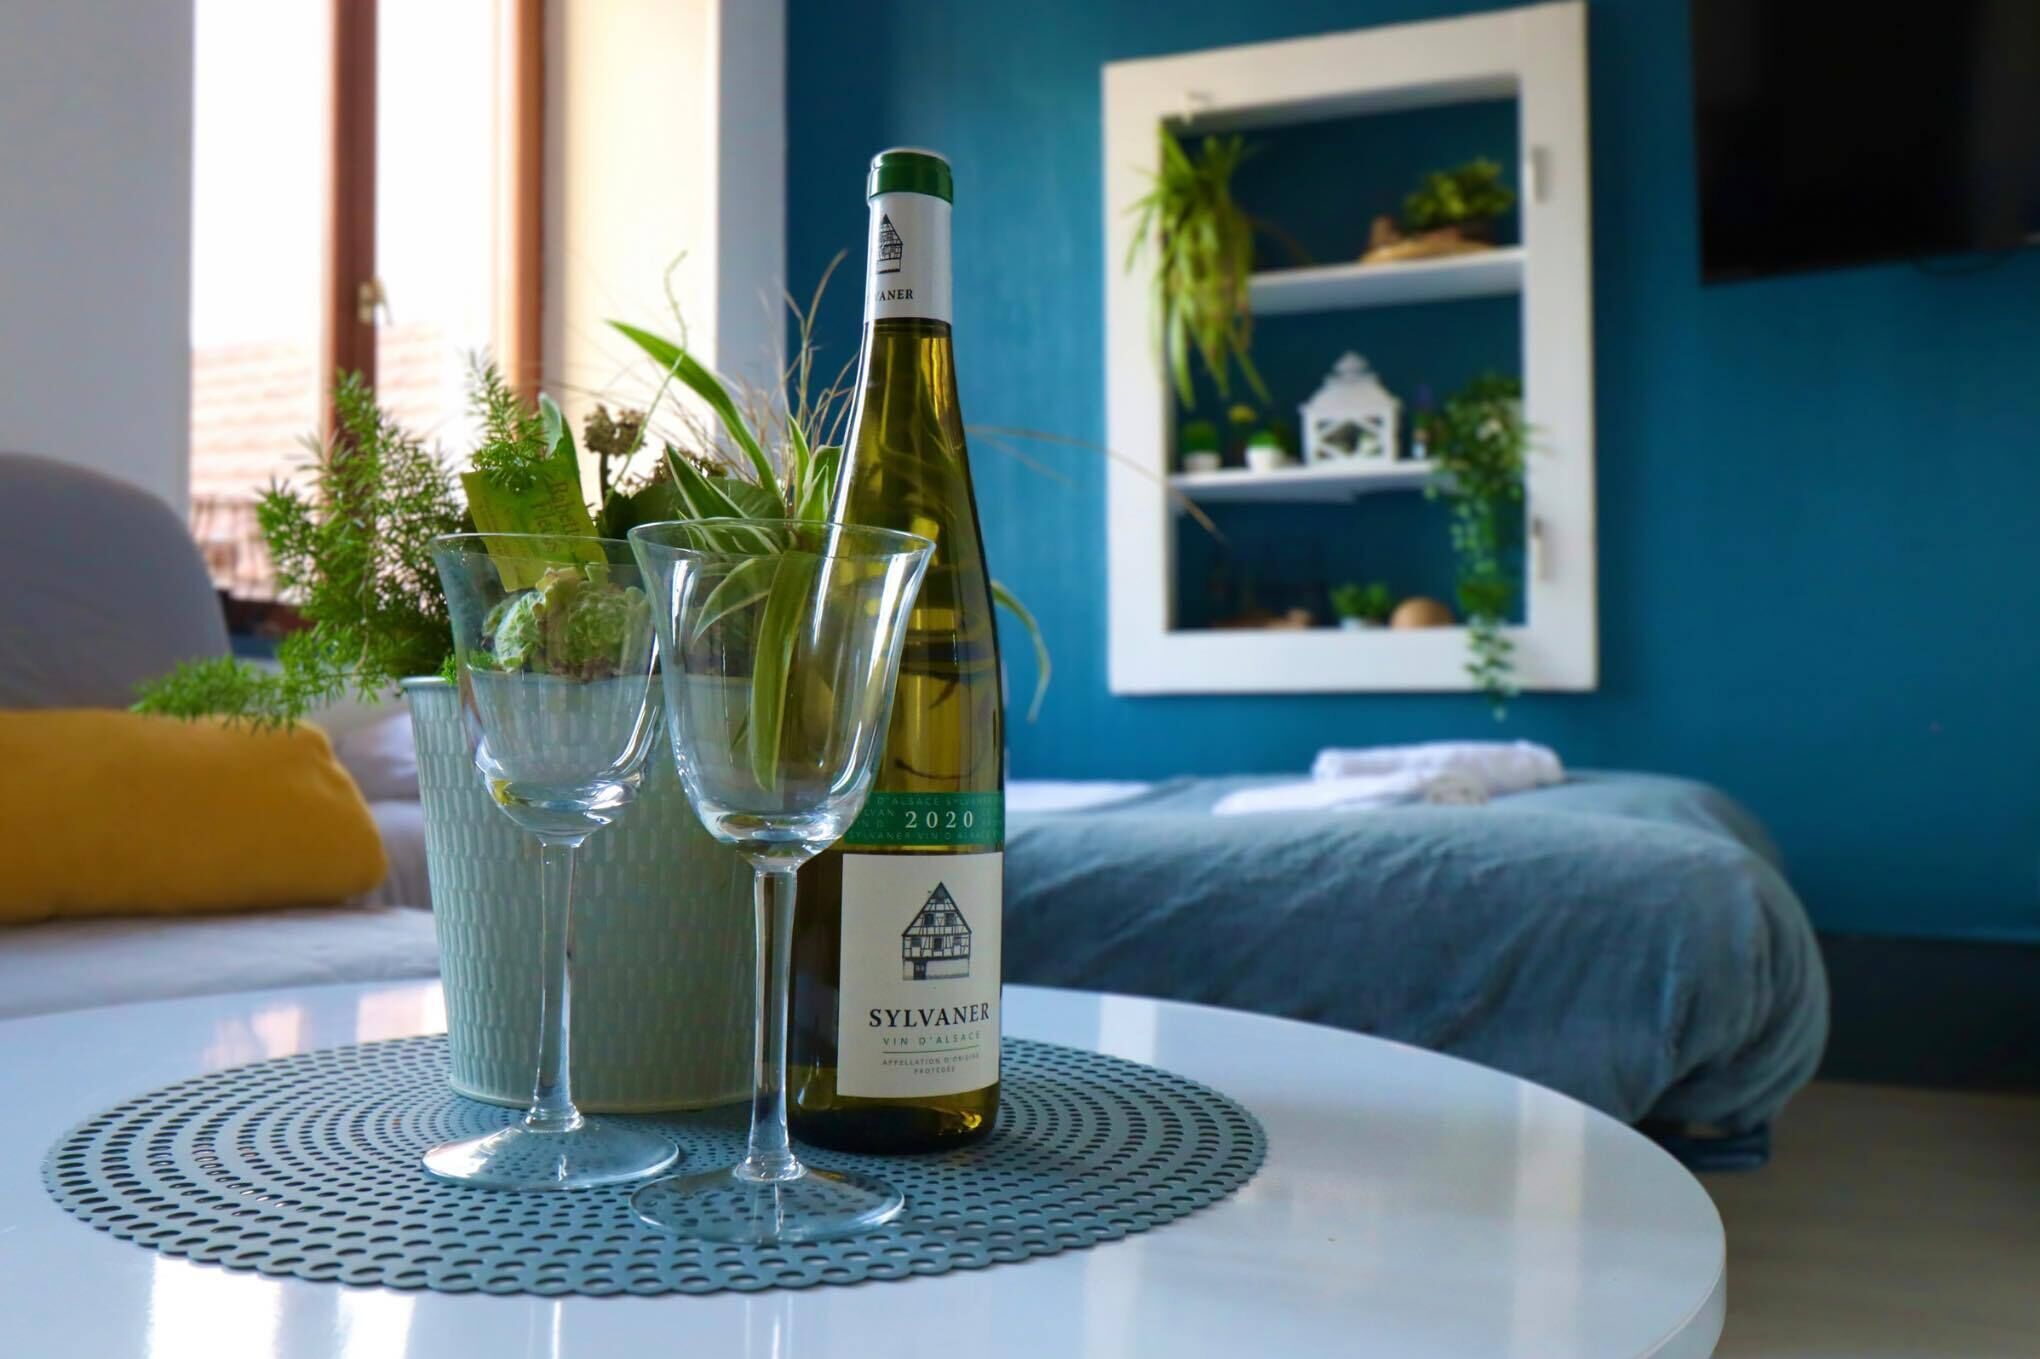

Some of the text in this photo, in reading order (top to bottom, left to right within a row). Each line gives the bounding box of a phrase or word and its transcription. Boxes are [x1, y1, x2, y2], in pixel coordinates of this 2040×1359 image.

[904, 810, 973, 829] 2020
[869, 1002, 990, 1028] SYLVANER
[882, 1030, 981, 1046] VIN D'ALSACE
[882, 1057, 941, 1066] APPELLATION
